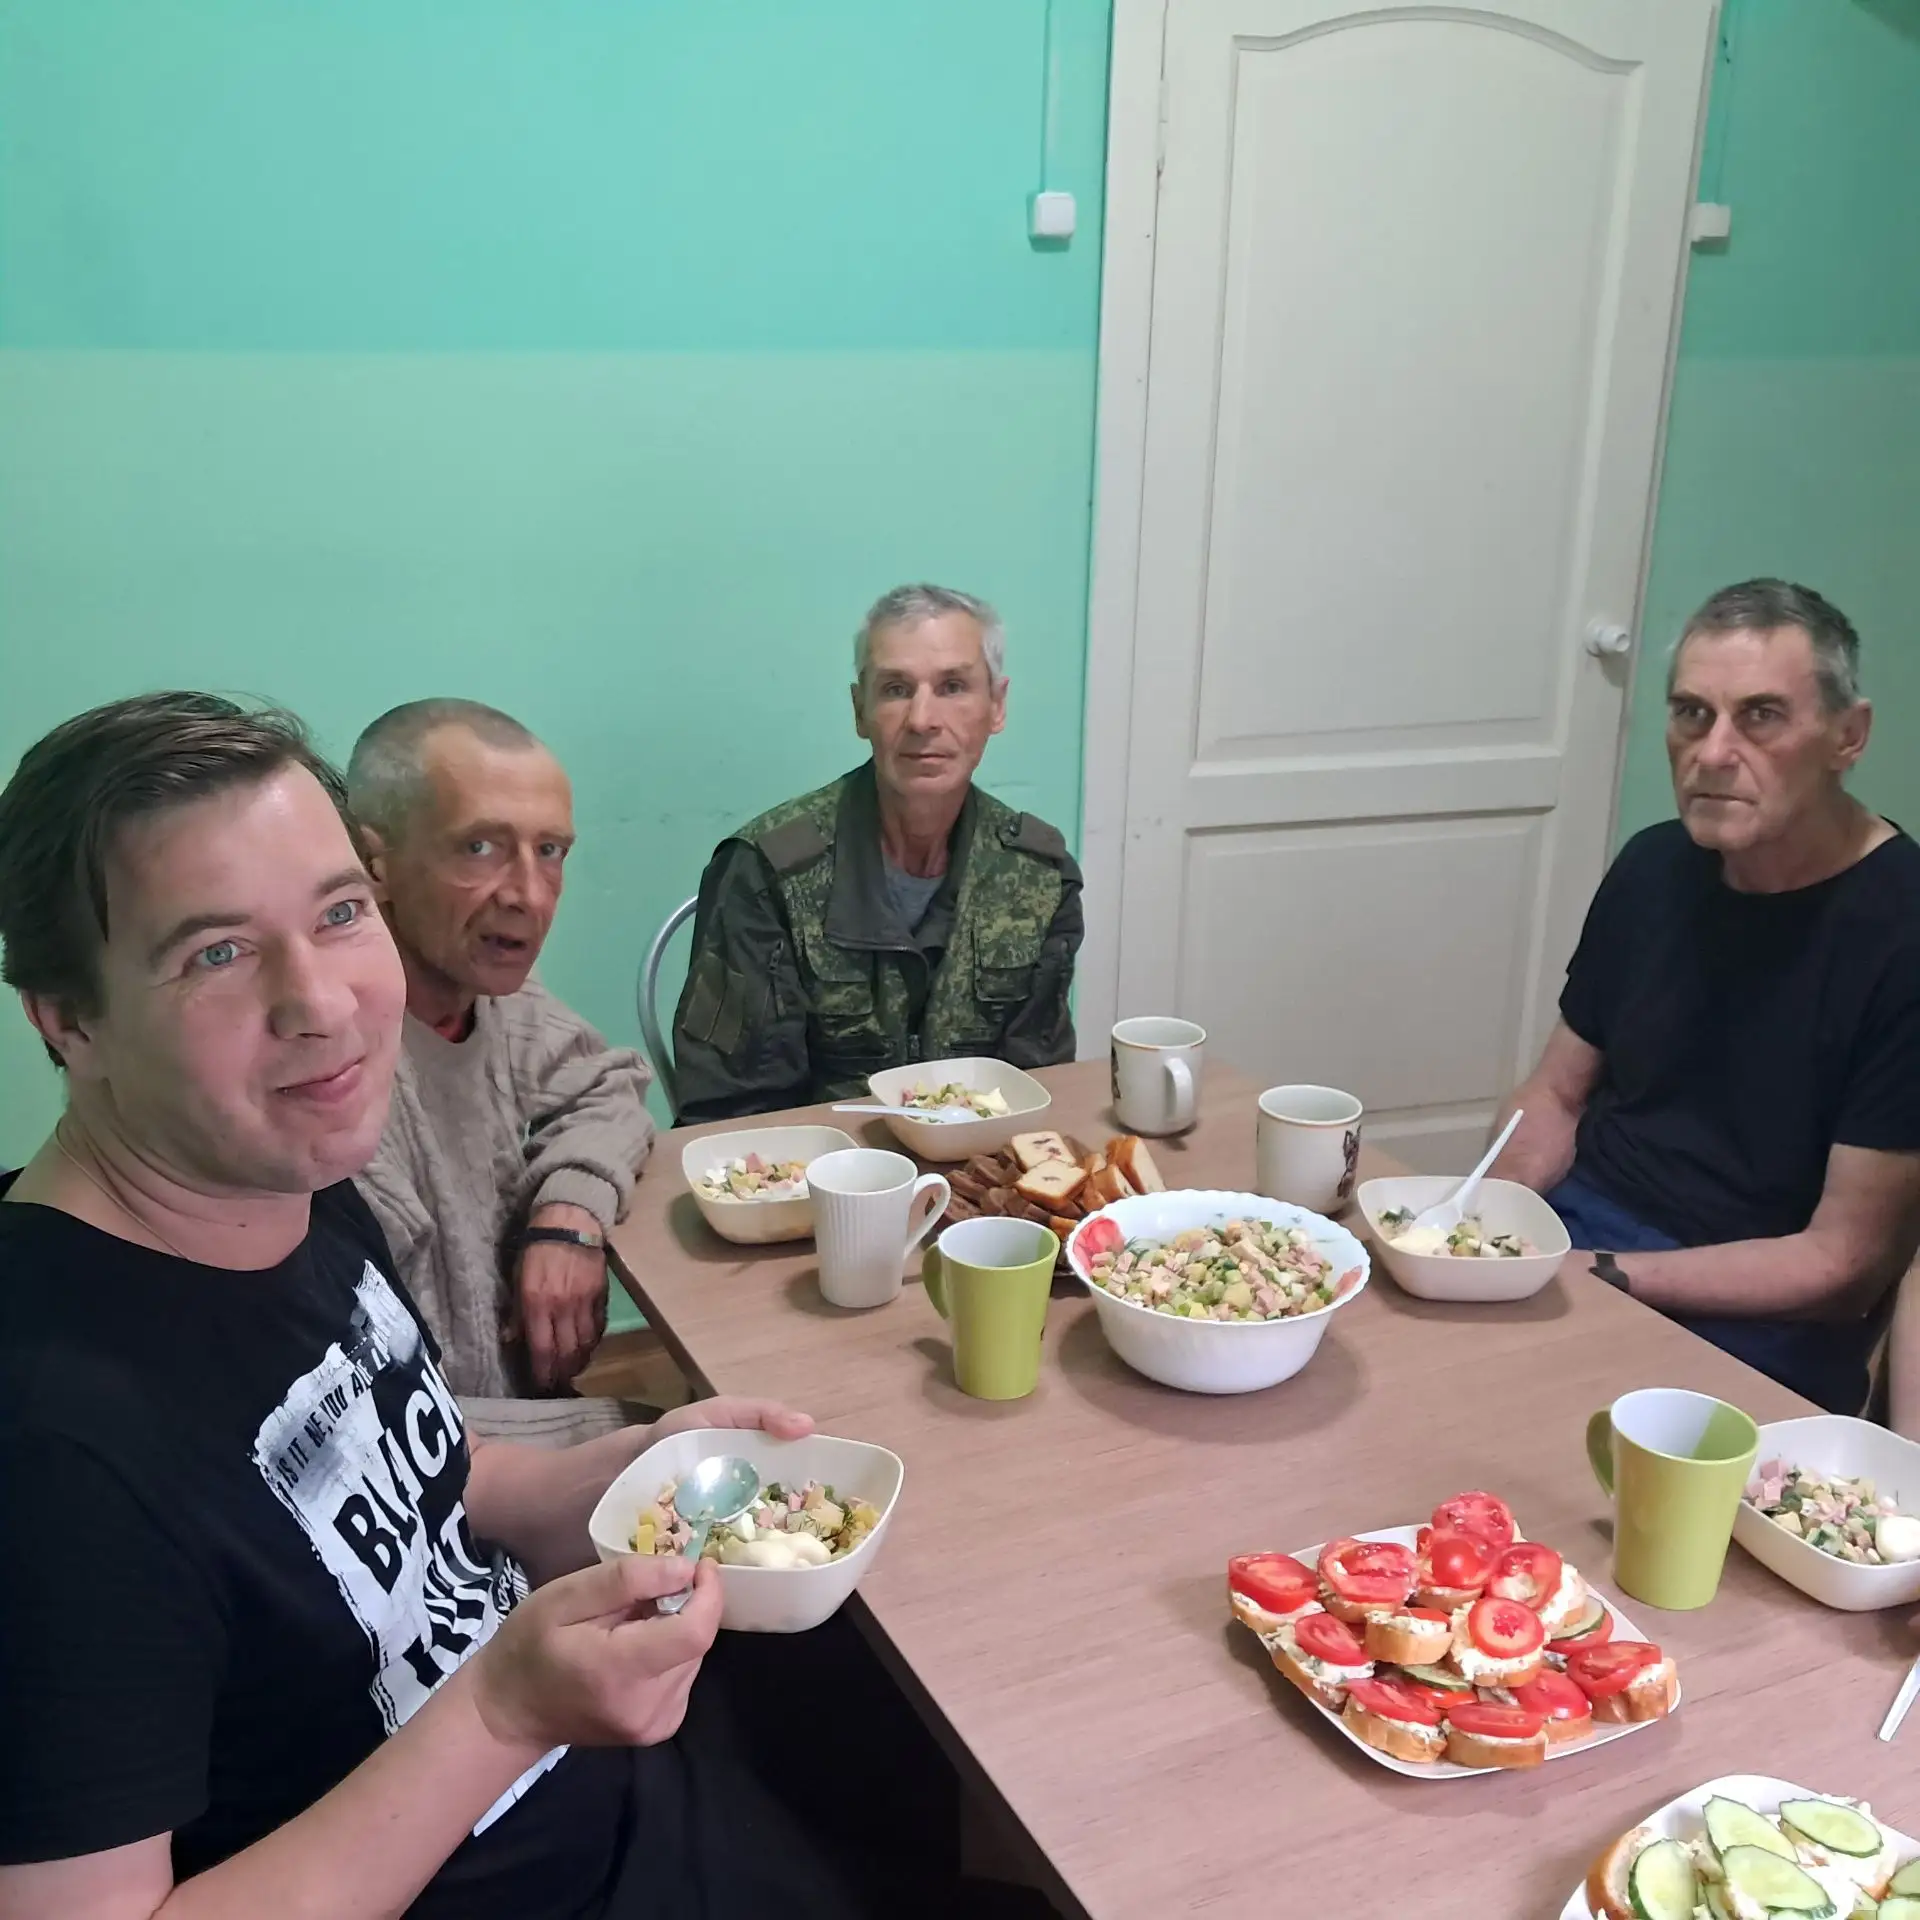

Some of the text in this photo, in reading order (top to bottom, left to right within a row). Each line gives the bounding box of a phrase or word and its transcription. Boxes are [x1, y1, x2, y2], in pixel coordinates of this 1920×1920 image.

[287, 1437, 310, 1470] IT
[276, 1457, 299, 1489] IS
[333, 1353, 465, 1596] BLACK
